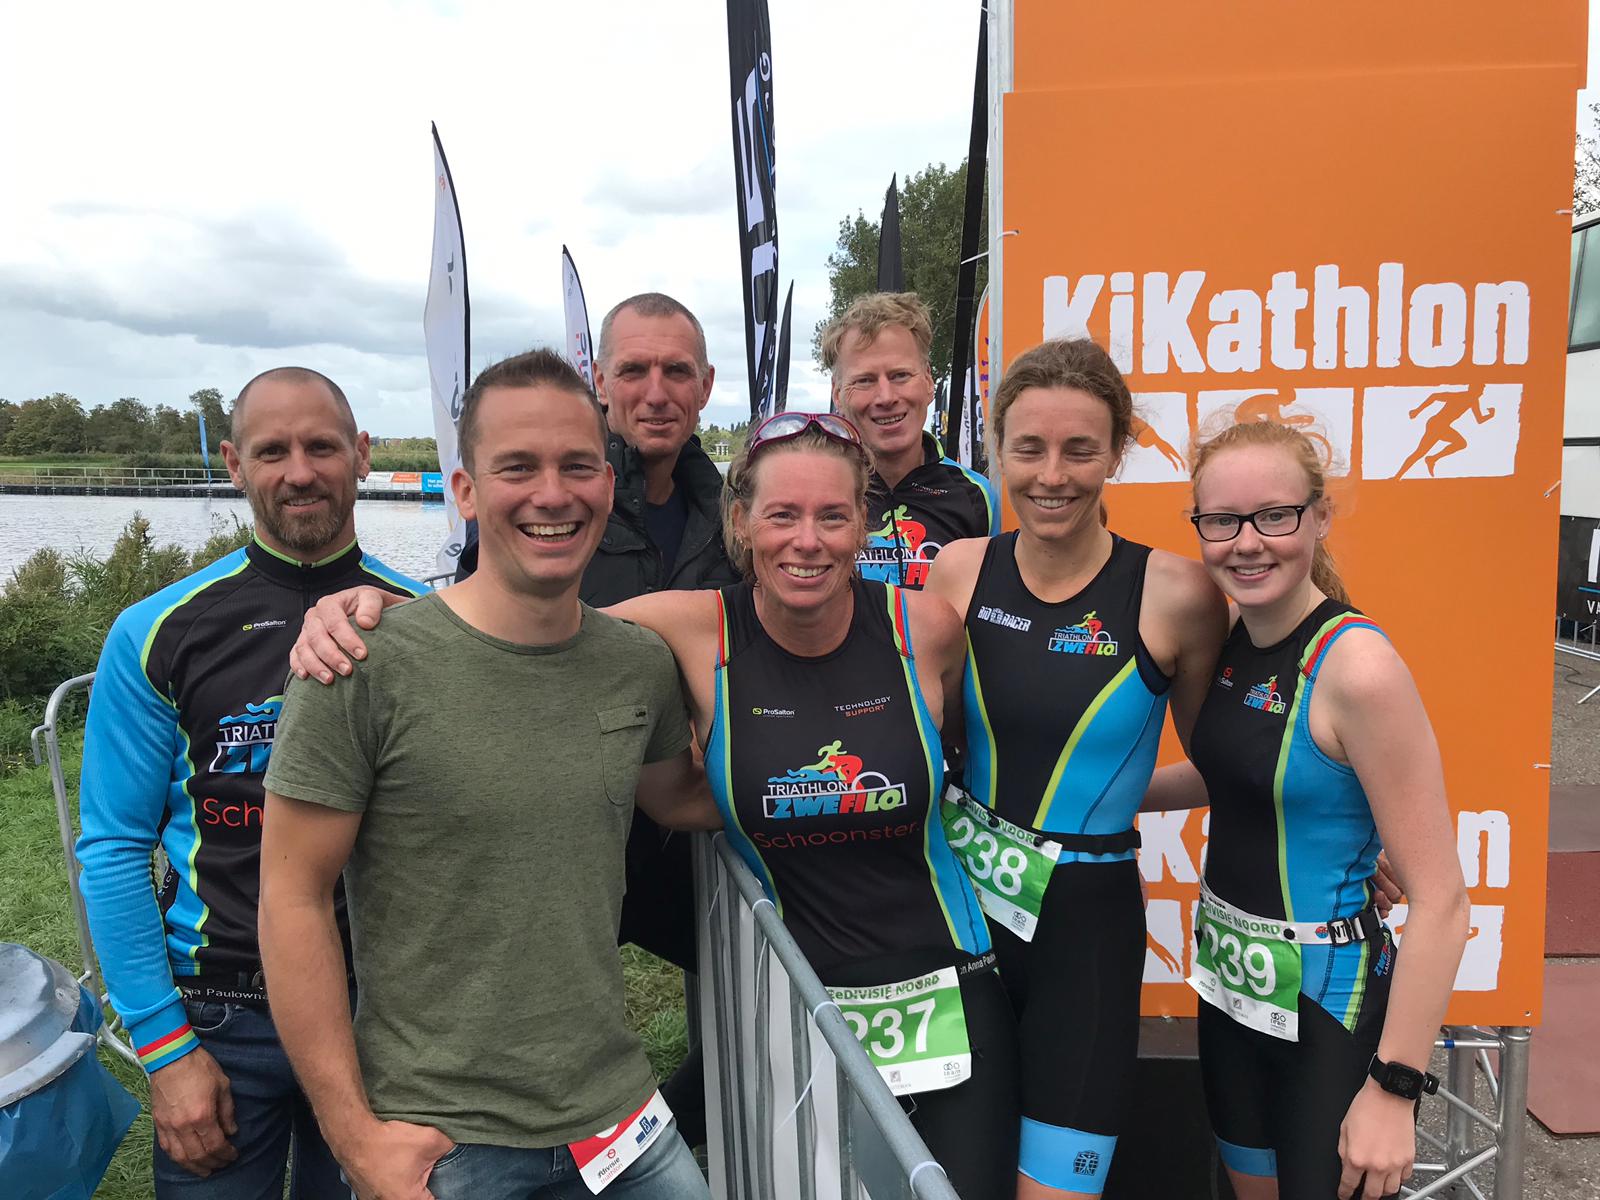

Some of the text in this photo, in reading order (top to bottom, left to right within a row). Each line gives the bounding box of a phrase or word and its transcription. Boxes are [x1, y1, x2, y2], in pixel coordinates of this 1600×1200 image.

[1043, 262, 1530, 374] KiKathlon
[855, 548, 914, 560] ATHLON
[1053, 632, 1093, 641] TRIATHLON
[1052, 640, 1115, 656] ZWEFILO
[763, 708, 795, 716] ProSalton
[834, 696, 892, 712] TECHNOLOGY
[845, 704, 885, 717] SUPPORT
[219, 723, 277, 742] TRIAT
[767, 781, 848, 796] TRIATHLON
[772, 789, 902, 819] ZWEFILO
[999, 820, 1036, 845] NOOR
[948, 817, 1028, 896] 238
[1234, 916, 1281, 935] NOORD
[1202, 922, 1276, 996] 239
[896, 975, 940, 995] NOORD
[842, 998, 936, 1059] 237
